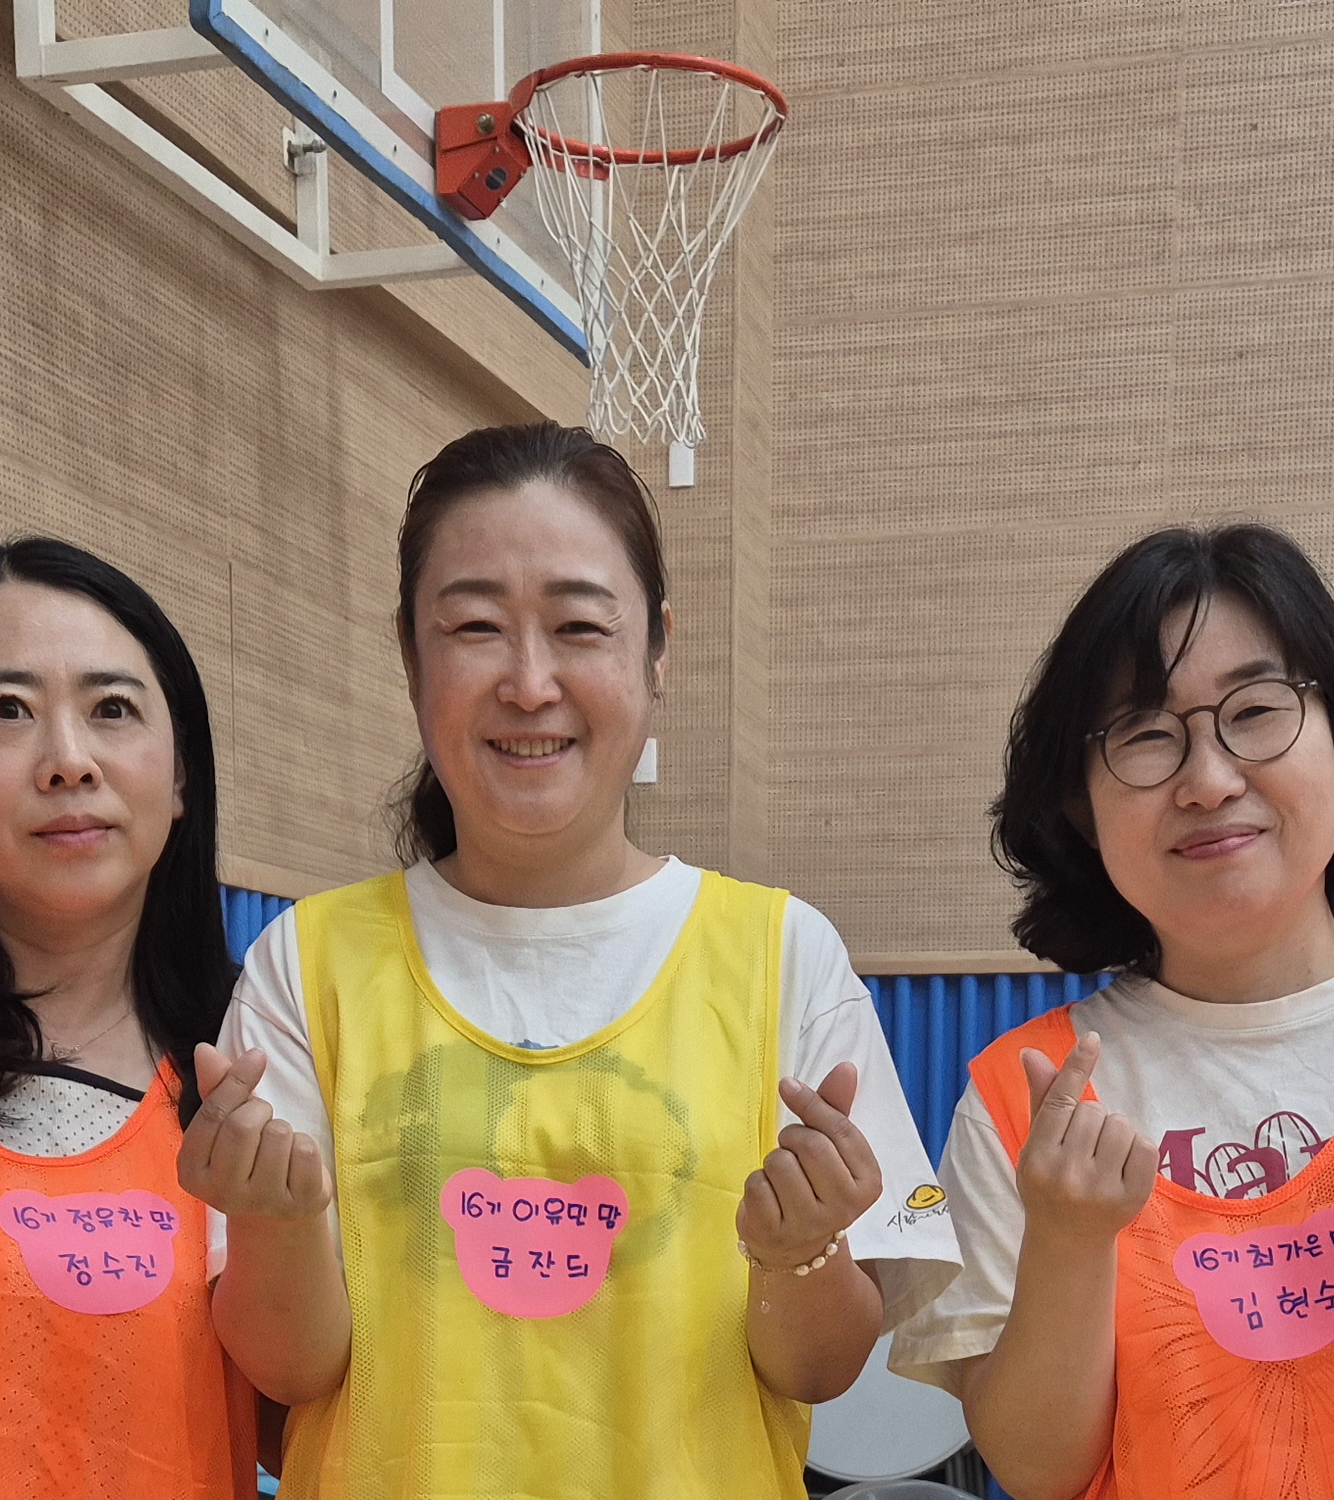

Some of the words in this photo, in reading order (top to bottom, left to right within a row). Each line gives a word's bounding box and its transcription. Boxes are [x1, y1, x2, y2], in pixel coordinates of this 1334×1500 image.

[13, 1206, 57, 1230] 16기
[66, 1207, 143, 1233] 정유찬
[149, 1210, 175, 1231] 맘
[461, 1191, 501, 1218] 16기
[512, 1197, 587, 1226] 이유민
[58, 1251, 157, 1286] 정수진
[1192, 1247, 1240, 1271] 16기
[1246, 1234, 1323, 1268] 최가은
